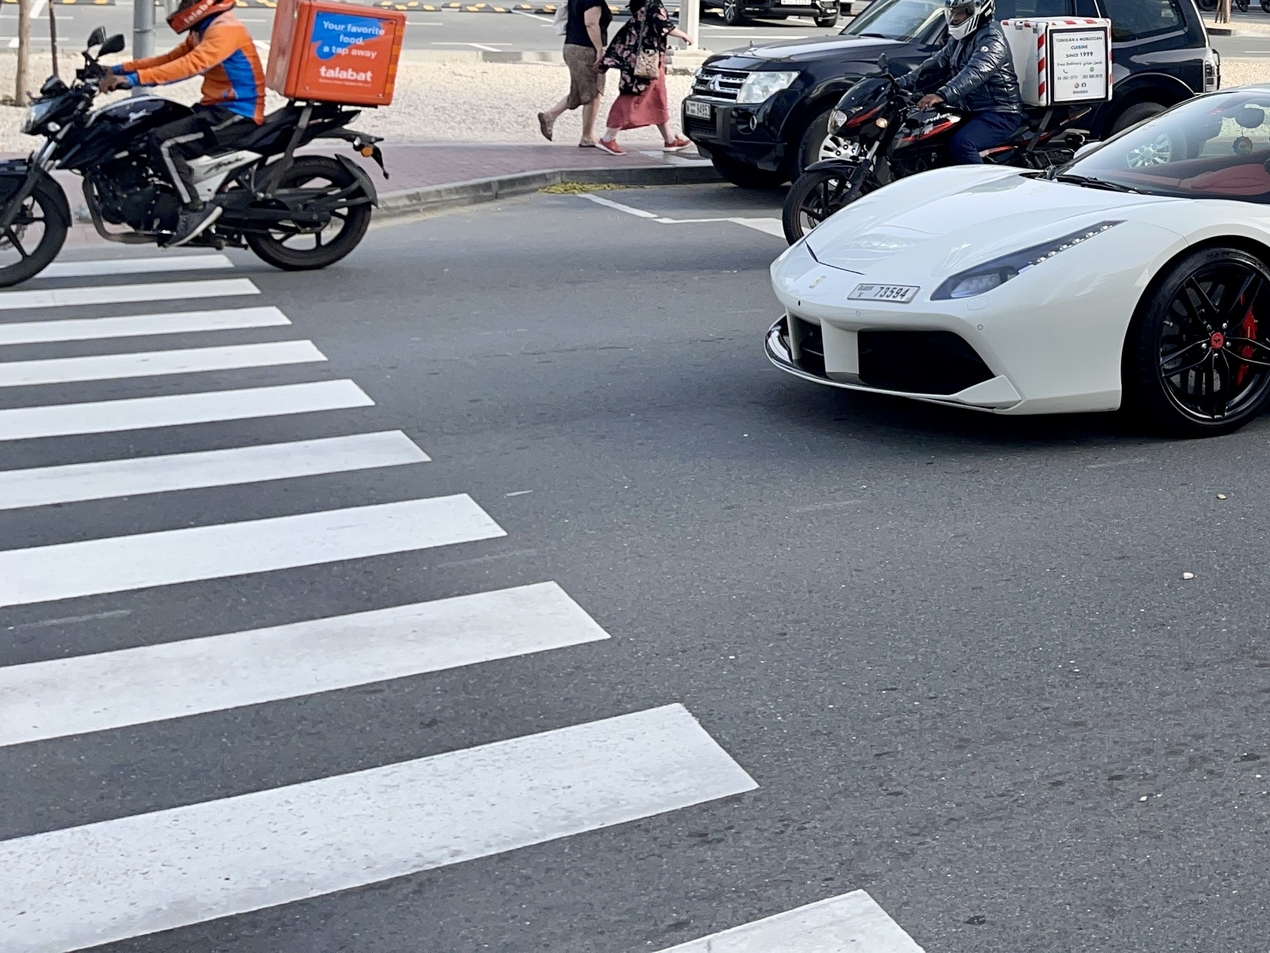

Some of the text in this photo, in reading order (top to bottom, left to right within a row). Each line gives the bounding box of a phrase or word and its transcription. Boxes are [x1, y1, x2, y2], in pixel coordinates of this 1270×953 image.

[323, 20, 385, 34] Your favorite
[332, 44, 349, 56] tap
[351, 49, 377, 60] away
[319, 66, 372, 82] talabat
[874, 286, 910, 300] 73594
